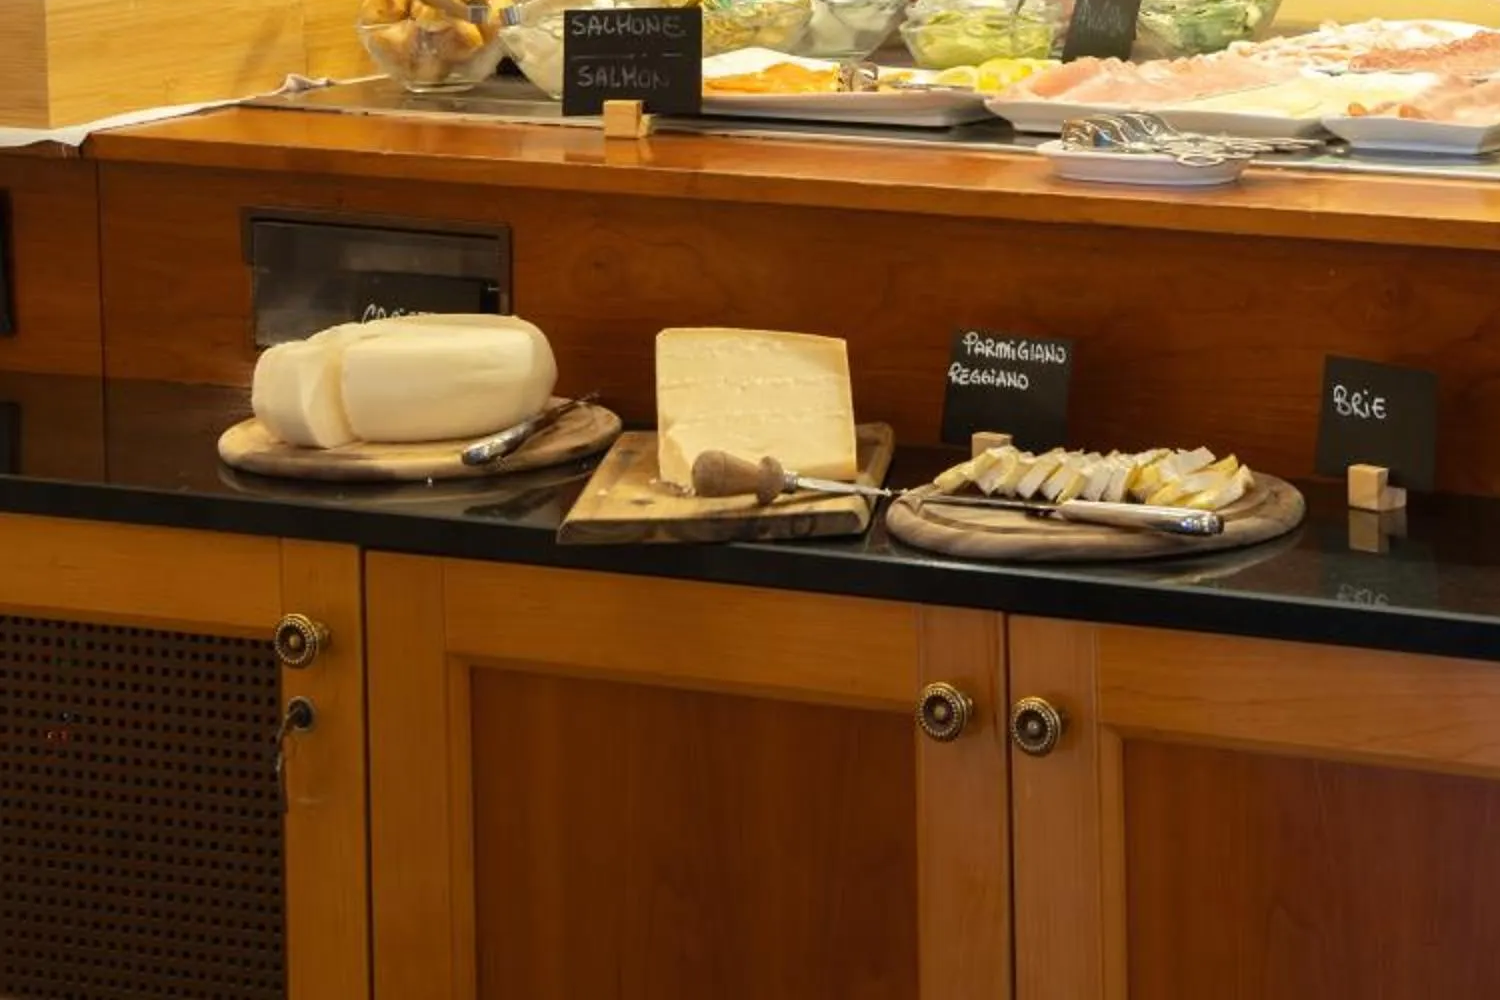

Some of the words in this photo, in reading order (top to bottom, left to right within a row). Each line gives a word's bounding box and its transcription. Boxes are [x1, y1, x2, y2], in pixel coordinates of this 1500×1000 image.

[571, 12, 687, 37] SALMONE
[576, 65, 670, 88] SALMON
[962, 331, 1067, 364] PARMIGIANO
[1333, 384, 1388, 419] BRIE
